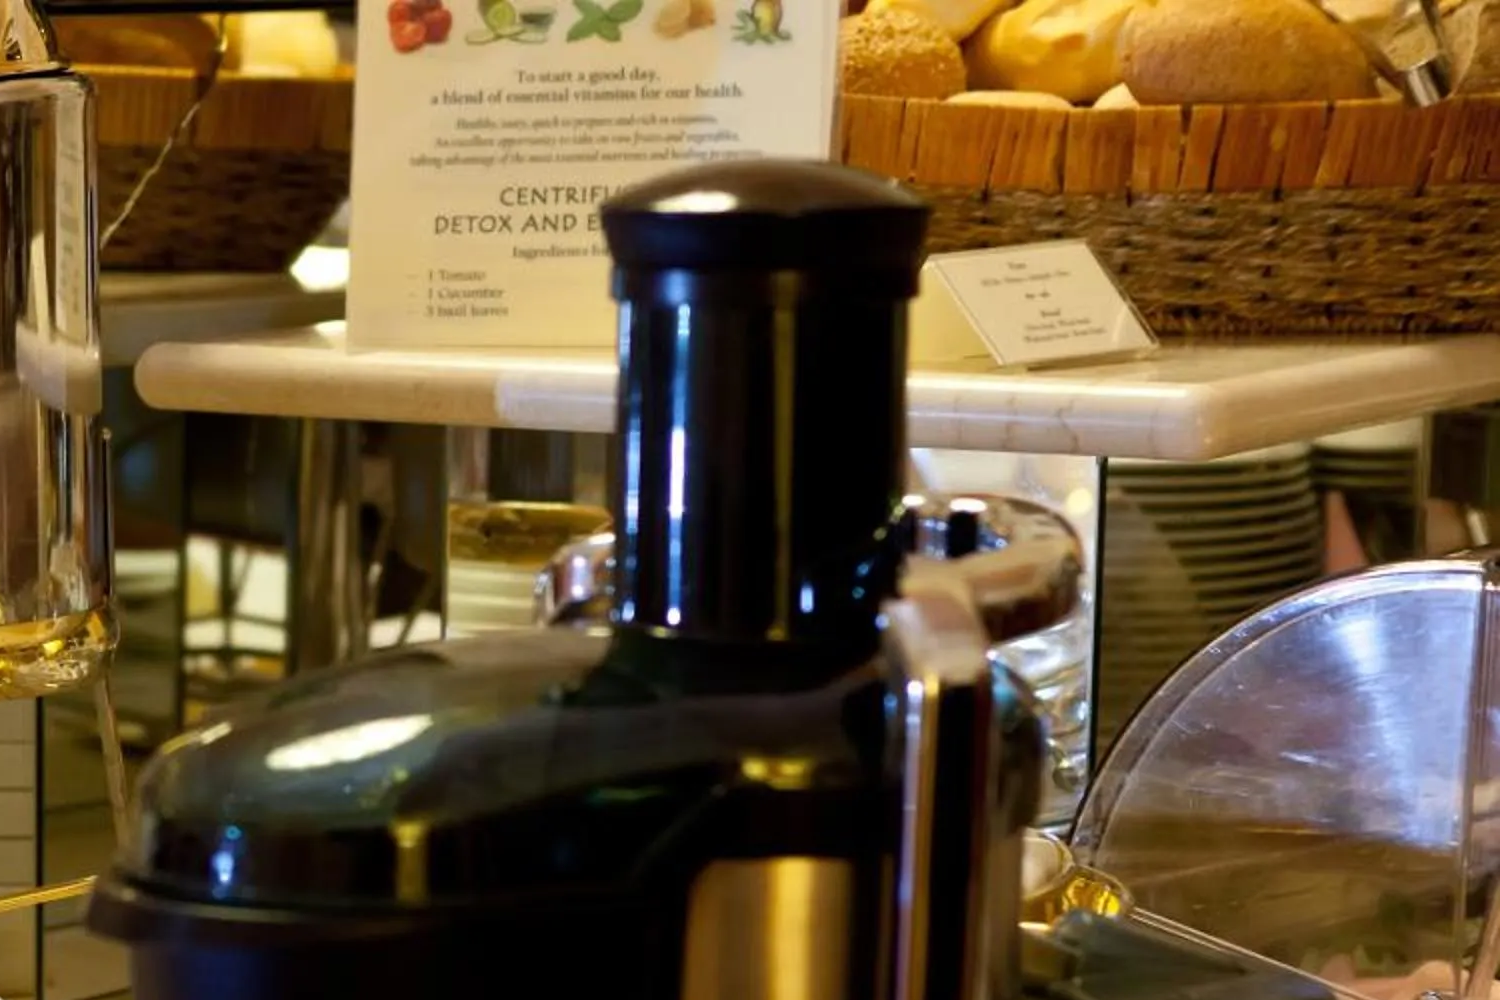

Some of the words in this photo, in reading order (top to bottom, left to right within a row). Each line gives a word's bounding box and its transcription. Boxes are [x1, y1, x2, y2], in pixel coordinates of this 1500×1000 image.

[517, 70, 535, 84] To
[538, 69, 572, 83] start
[577, 71, 585, 81] a
[588, 65, 625, 86] good
[430, 94, 439, 106] a
[442, 88, 483, 106] blend
[487, 89, 503, 104] of
[506, 87, 569, 105] essential
[573, 86, 637, 102] vitamins
[640, 84, 661, 100] for
[665, 88, 691, 99] our
[498, 185, 622, 207] CENTRIFU
[434, 213, 513, 235] DETOX
[521, 213, 578, 233] AND
[512, 245, 588, 260] Ingredients
[591, 244, 611, 258] fo
[437, 269, 487, 282] Tomato
[437, 287, 505, 301] Cucumber
